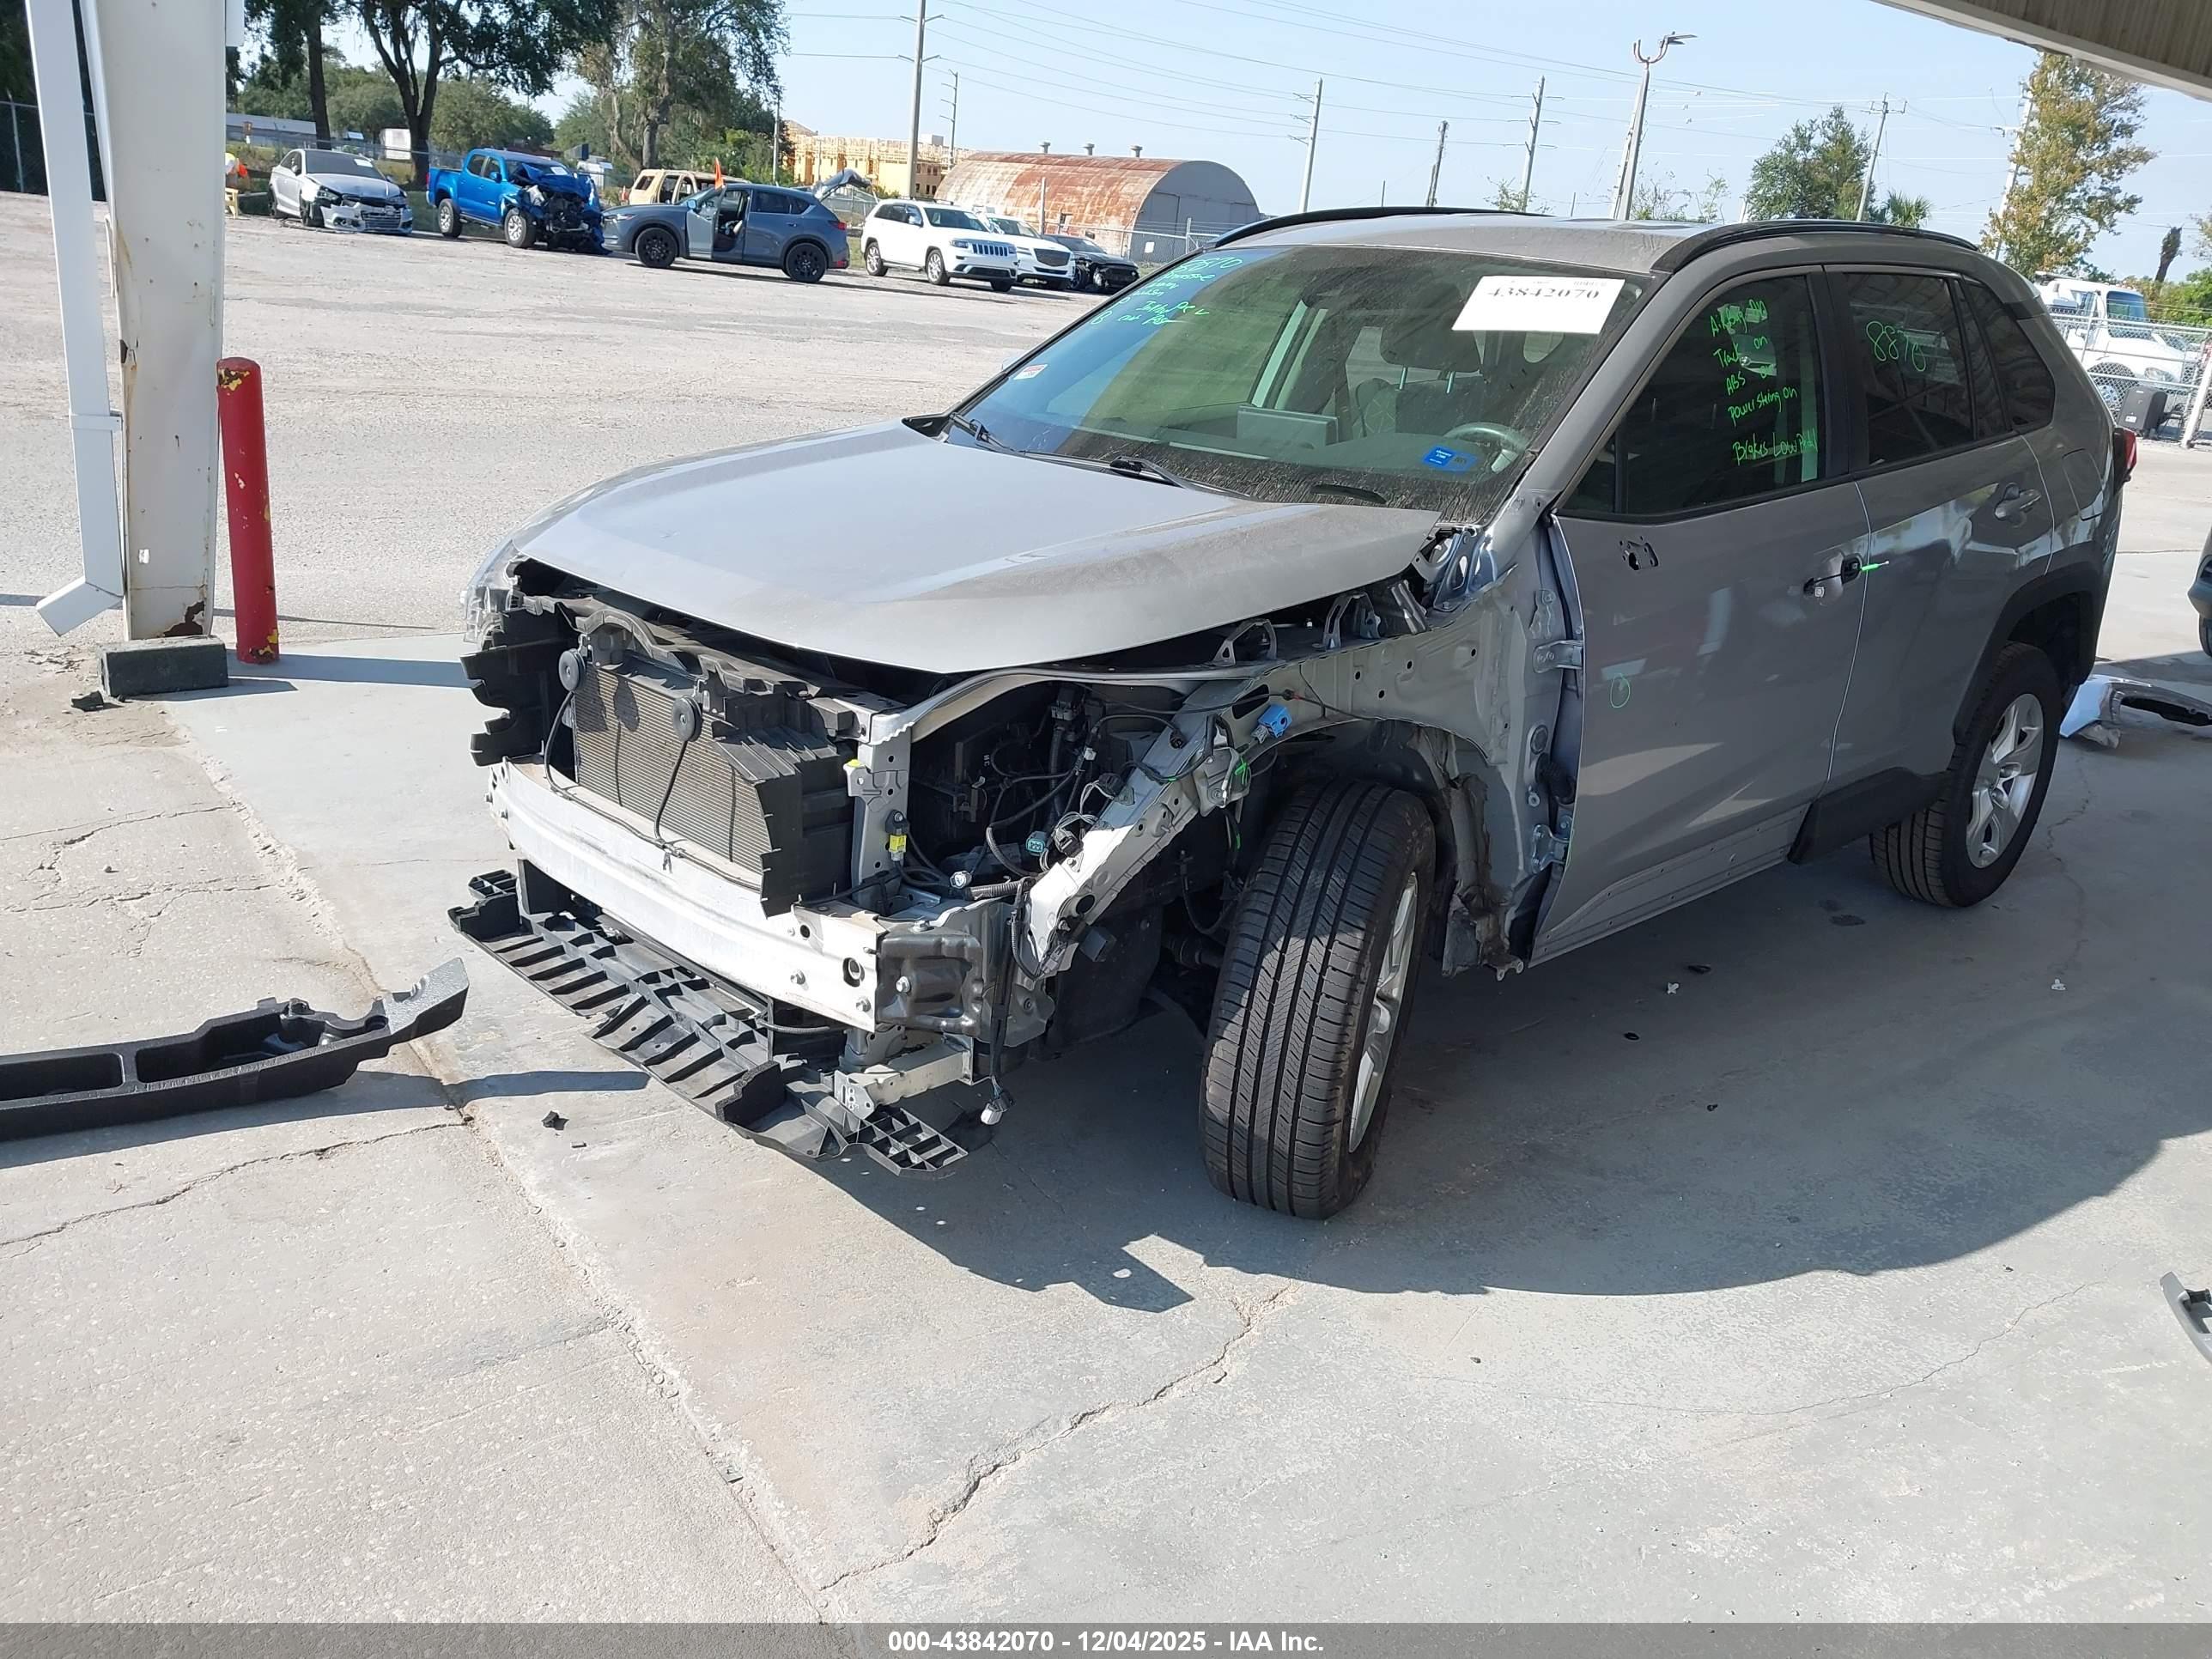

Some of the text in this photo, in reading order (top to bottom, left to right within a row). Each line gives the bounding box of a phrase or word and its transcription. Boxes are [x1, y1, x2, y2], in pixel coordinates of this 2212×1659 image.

[1488, 288, 1599, 299] 43842070
[1866, 320, 1926, 372] 8870
[1726, 371, 1746, 395] ABS
